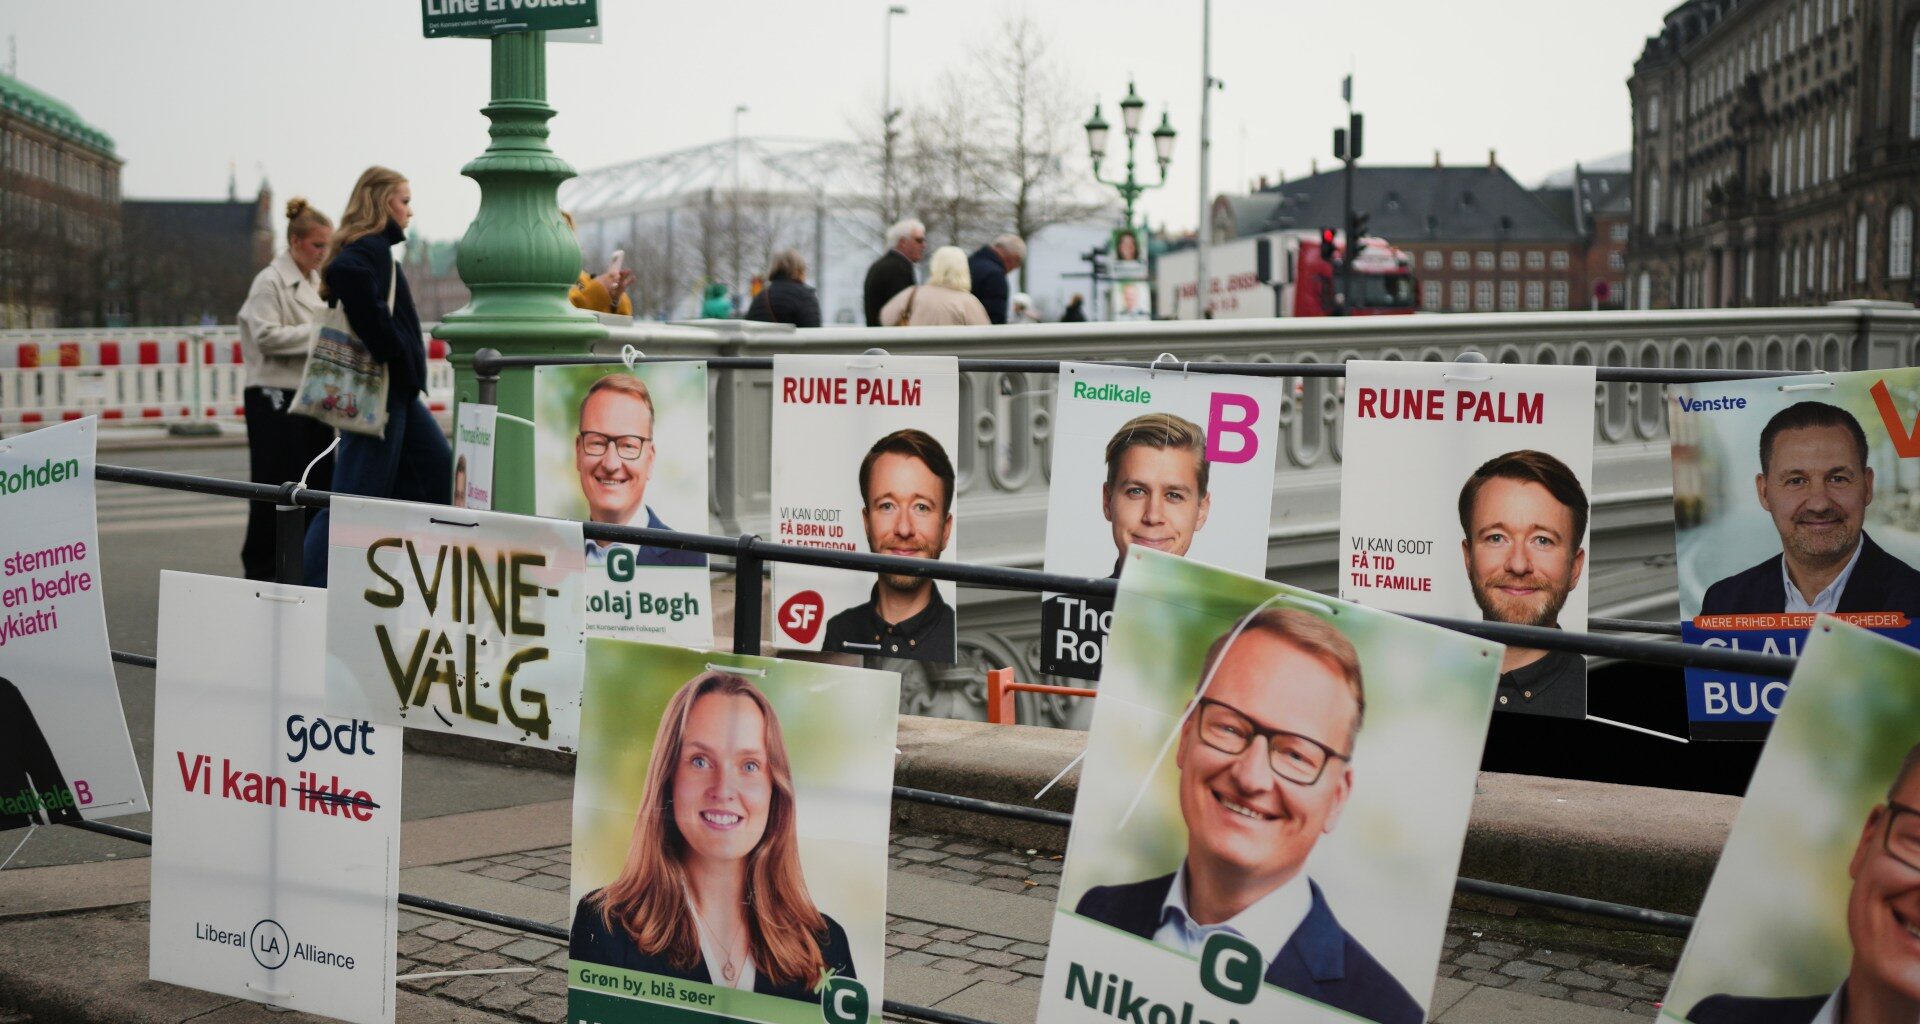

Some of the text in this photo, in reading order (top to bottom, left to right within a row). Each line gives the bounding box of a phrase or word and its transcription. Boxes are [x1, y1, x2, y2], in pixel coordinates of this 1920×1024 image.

[783, 377, 921, 406] RUNE PALM
[1073, 381, 1151, 404] Radikale
[1358, 388, 1544, 424] RUNE PALM
[1679, 395, 1747, 412] Venstre
[1205, 392, 1260, 464] B
[780, 507, 841, 521] VI KAN GODT
[780, 519, 844, 538] FÅ BØRN UD
[4, 541, 87, 577] stemme
[1352, 536, 1434, 555] VI KAN GODT
[1351, 550, 1395, 571] FÅ TID
[3, 570, 92, 608] en bedre
[1351, 573, 1432, 592] TIL FAMILIE
[639, 592, 700, 622] Bøgh
[787, 603, 818, 629] SF
[1701, 617, 1733, 628] MERE
[1735, 616, 1778, 627] FRIHED.
[1781, 615, 1815, 627] FLERE
[286, 714, 375, 762] godt
[74, 780, 94, 805] B
[177, 751, 375, 822] Vi kan ikke
[196, 922, 355, 970] Liberal LA Alliance
[579, 968, 715, 1006] Grøn by, blå søer
[1065, 961, 1240, 1024] Nikol
